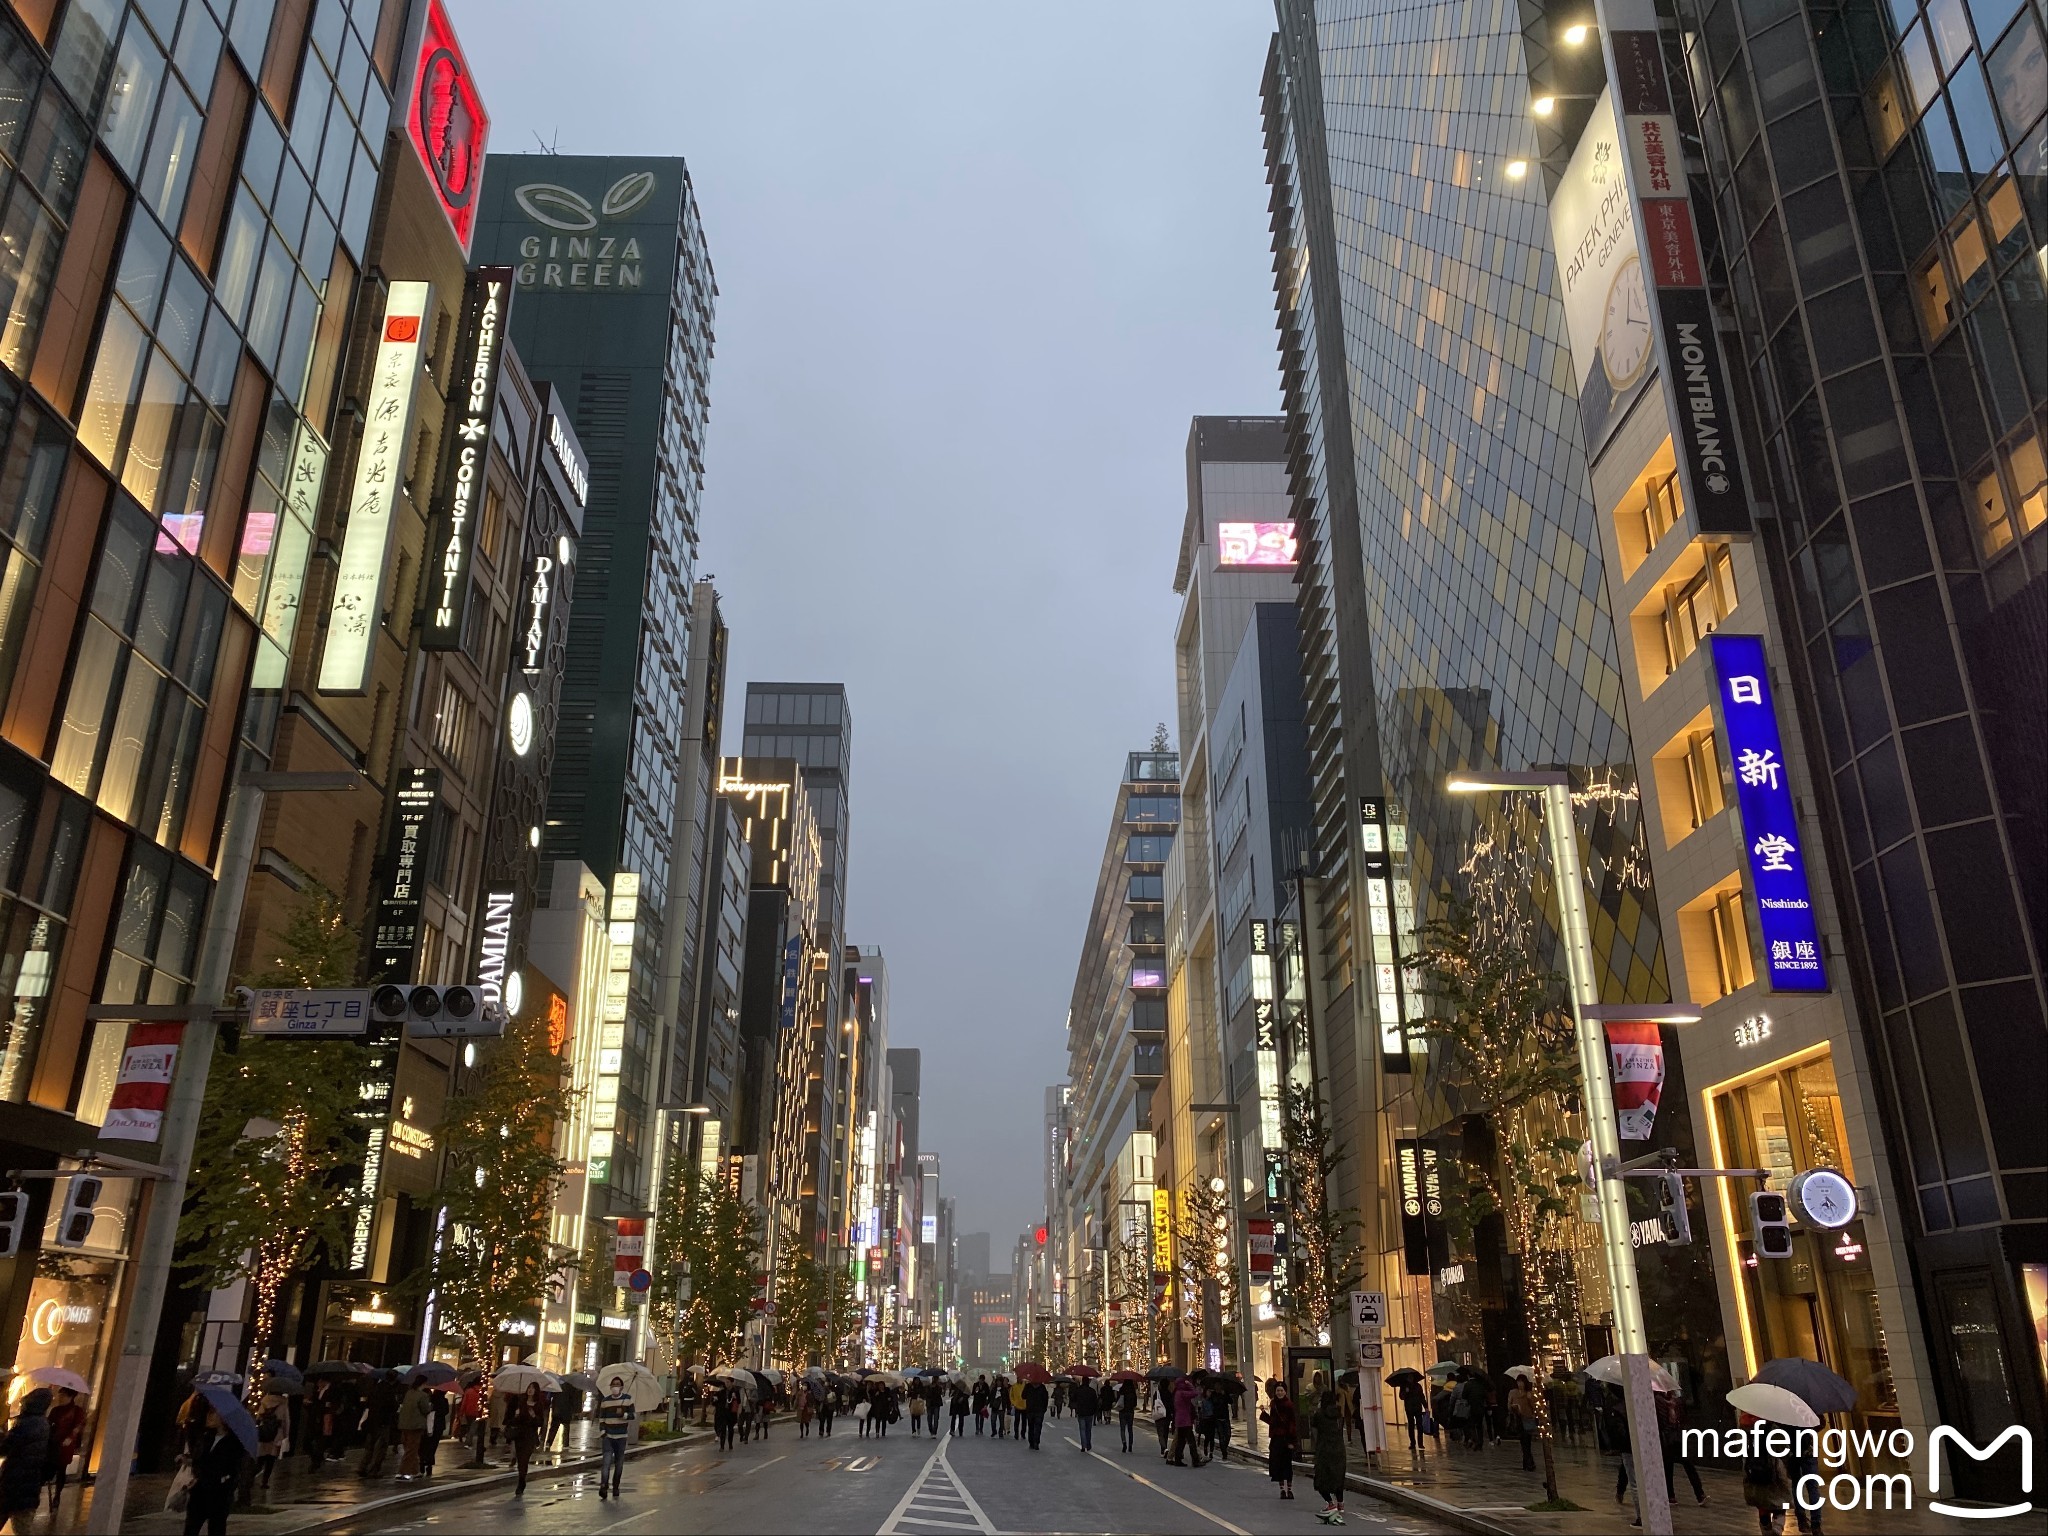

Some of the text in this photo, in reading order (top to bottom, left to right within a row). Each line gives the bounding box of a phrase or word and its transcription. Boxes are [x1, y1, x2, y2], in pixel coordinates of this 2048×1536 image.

[1641, 121, 1671, 191] 共立美容外科
[520, 235, 642, 260] GINZA
[1566, 214, 1602, 293] PATEK
[1598, 202, 1632, 268] GENEVE
[1659, 204, 1686, 283] 東京美容外科
[516, 262, 642, 288] GREEN
[1676, 323, 1726, 472] MONTBLANC
[435, 281, 501, 627] VACHERON CONSTANTIN
[550, 413, 589, 508] DAMIANI
[526, 556, 551, 668] DAMIANI
[1729, 675, 1796, 871] 日新堂
[394, 825, 419, 899] 買取専門店
[1761, 898, 1809, 908] Nisshindo
[478, 892, 514, 1004] DAMIANI
[1771, 940, 1817, 960] 銀座
[1774, 961, 1818, 969] SINCE 1892
[259, 1001, 361, 1018] 銀座七丁目
[262, 990, 294, 999] 中央区
[287, 1020, 328, 1029] Ginza 7
[107, 1119, 156, 1129] SHISEIDO
[1400, 1148, 1419, 1200] YAMAHA
[1639, 1217, 1666, 1245] YAMA
[1355, 1295, 1381, 1303] TAXI
